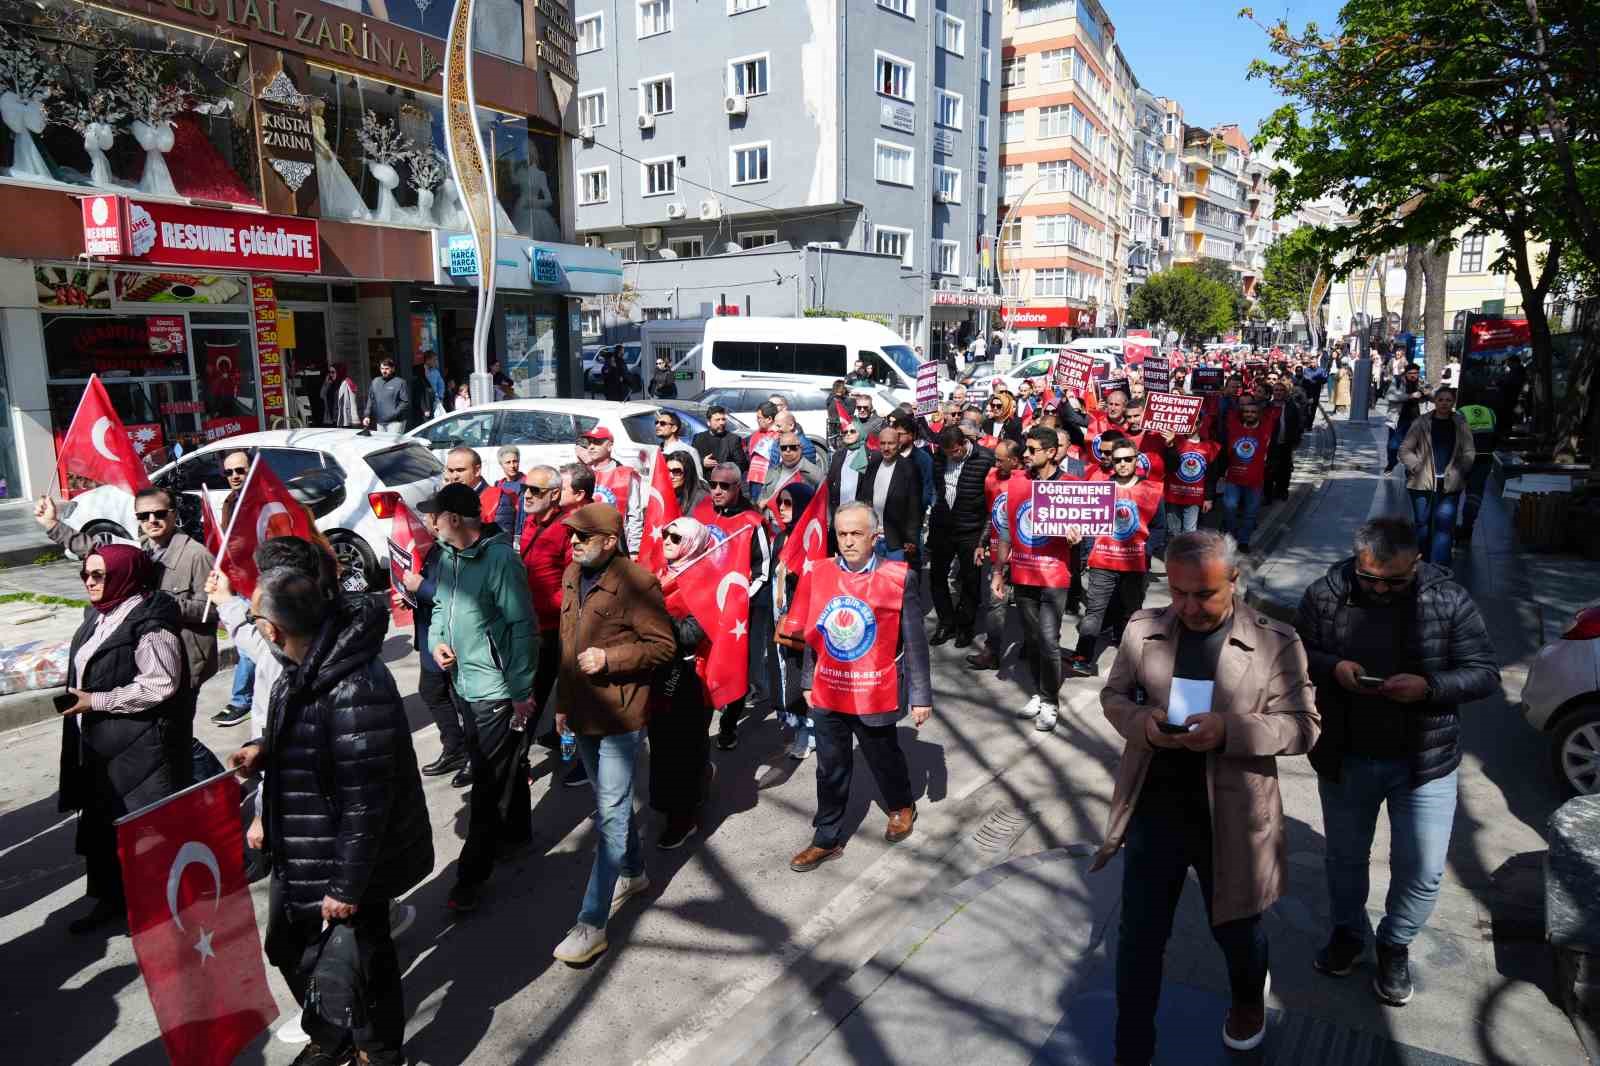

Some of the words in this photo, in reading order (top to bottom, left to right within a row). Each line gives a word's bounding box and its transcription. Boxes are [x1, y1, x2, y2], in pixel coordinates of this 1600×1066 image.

[293, 10, 418, 74] ZARİNA
[263, 112, 313, 135] KRİSTAL
[263, 130, 313, 151] ZARİNA
[161, 222, 236, 253] RESUME
[239, 225, 314, 259] ÇİĞKÖFTE
[451, 251, 475, 259] HARCA
[452, 259, 476, 267] HARCA
[1151, 394, 1200, 407] ÖĞRETMENE
[1150, 403, 1196, 415] UZANAN
[1153, 411, 1189, 424] ELLER
[1143, 420, 1192, 433] KIRILSIN!
[1037, 483, 1111, 495] ÖĞRETMENE
[1048, 495, 1100, 505] YÖNELİK
[1037, 504, 1110, 522] ŞİDDETİ
